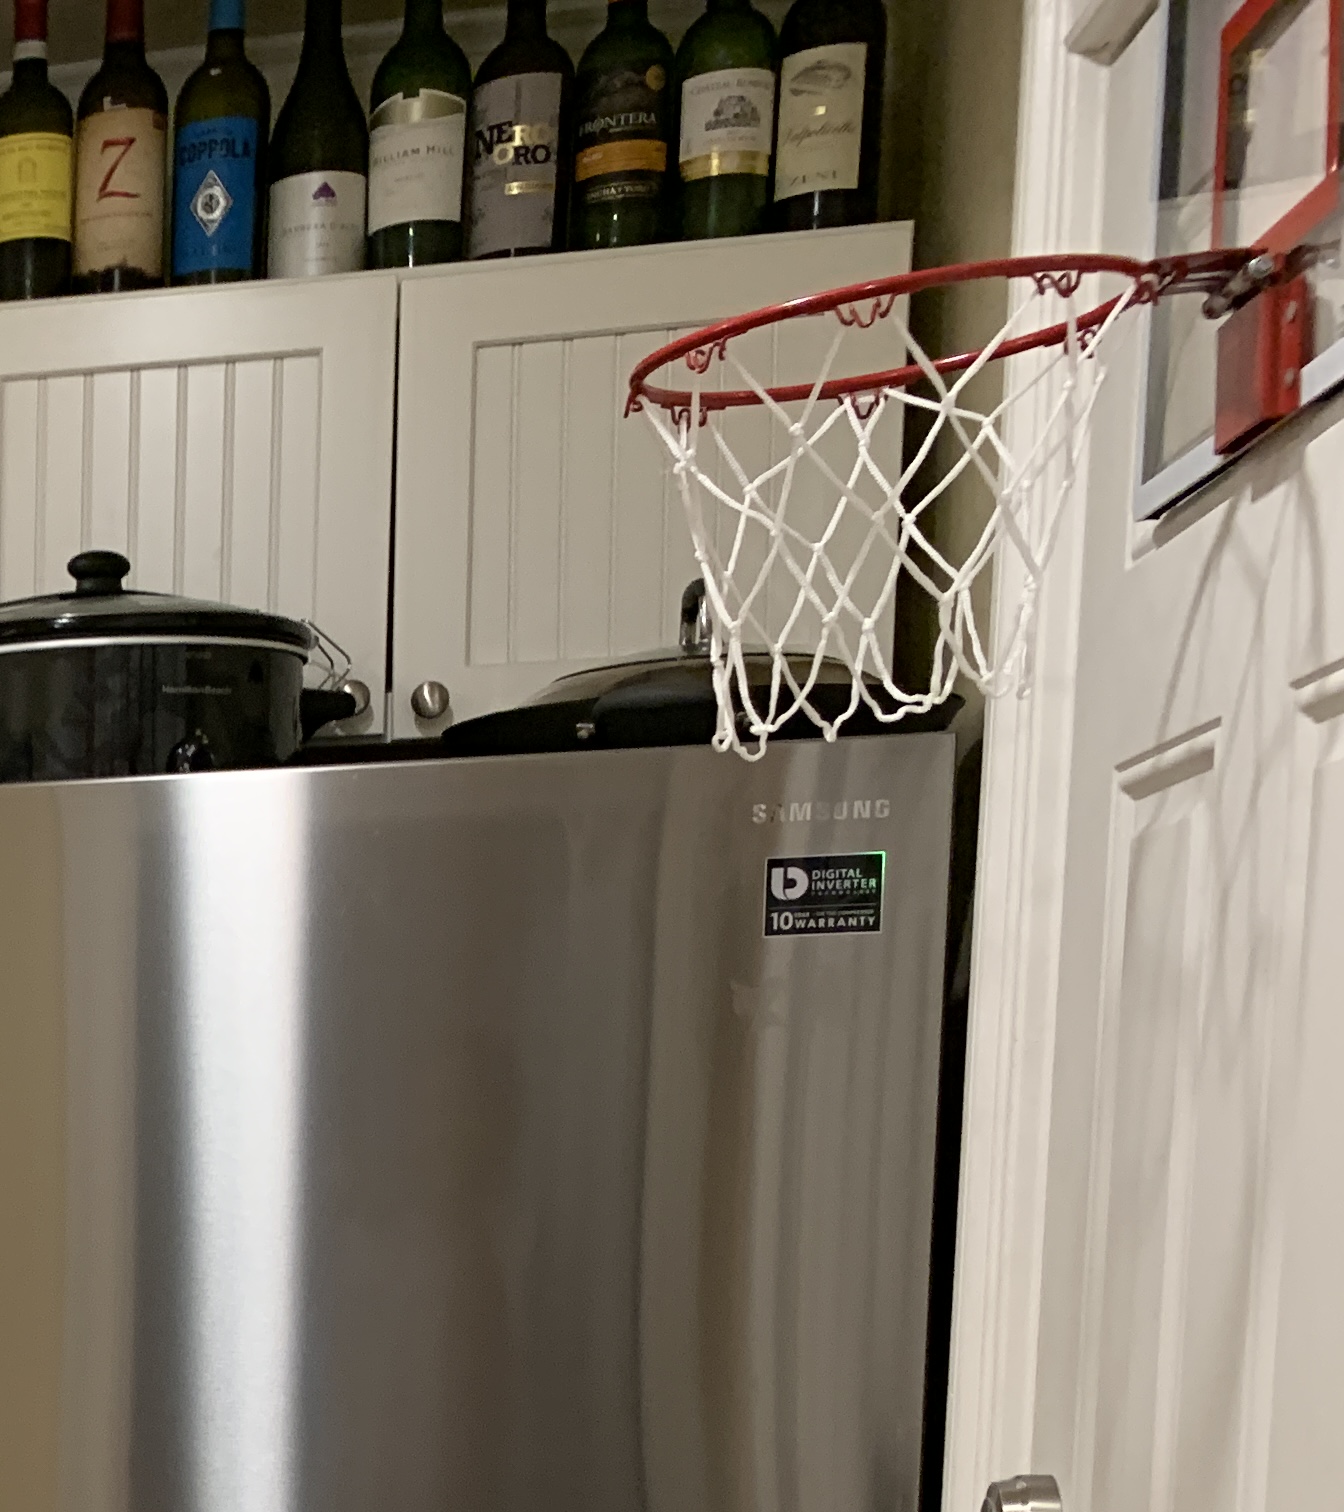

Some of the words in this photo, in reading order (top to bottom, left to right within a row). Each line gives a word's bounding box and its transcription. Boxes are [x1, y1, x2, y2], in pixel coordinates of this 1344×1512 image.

[475, 120, 551, 160] NERO
[492, 143, 552, 166] ORO
[96, 137, 141, 203] Z
[812, 868, 863, 880] DIGITAL
[812, 878, 877, 891] INVERTER
[771, 911, 794, 931] 10
[794, 916, 876, 929] WARRANTY
